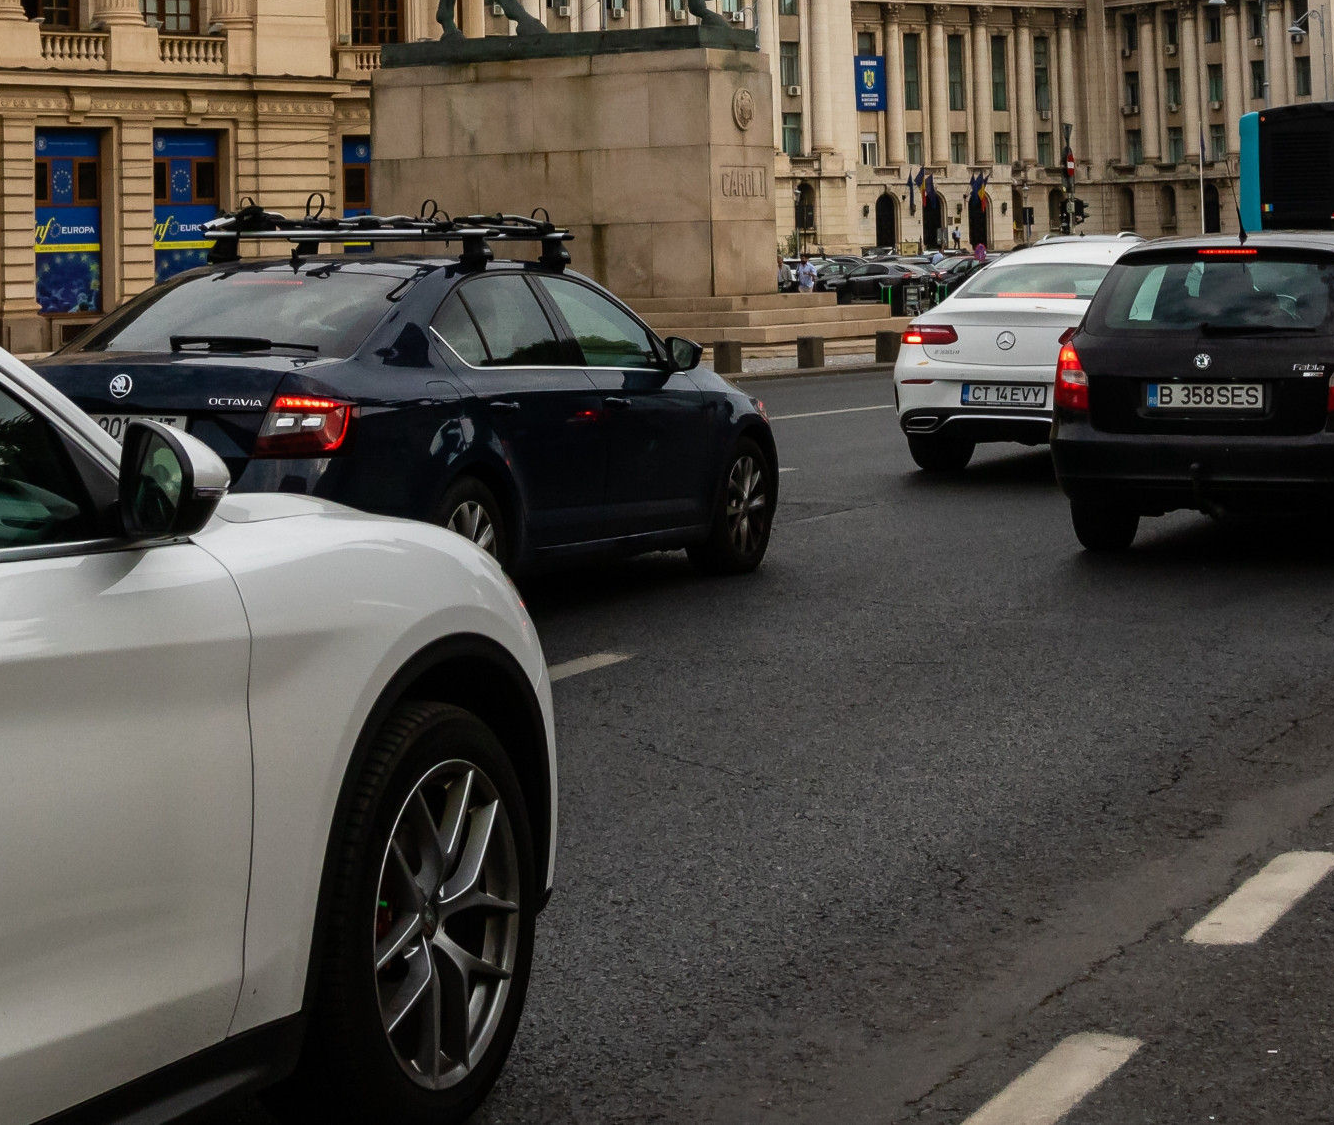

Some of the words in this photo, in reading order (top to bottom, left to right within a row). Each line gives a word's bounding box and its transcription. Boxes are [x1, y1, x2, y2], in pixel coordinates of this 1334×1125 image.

[61, 226, 95, 234] EUROPA
[180, 224, 202, 232] EURO
[972, 387, 990, 401] CT
[1160, 386, 1172, 405] B
[208, 397, 263, 408] OCTAVIA
